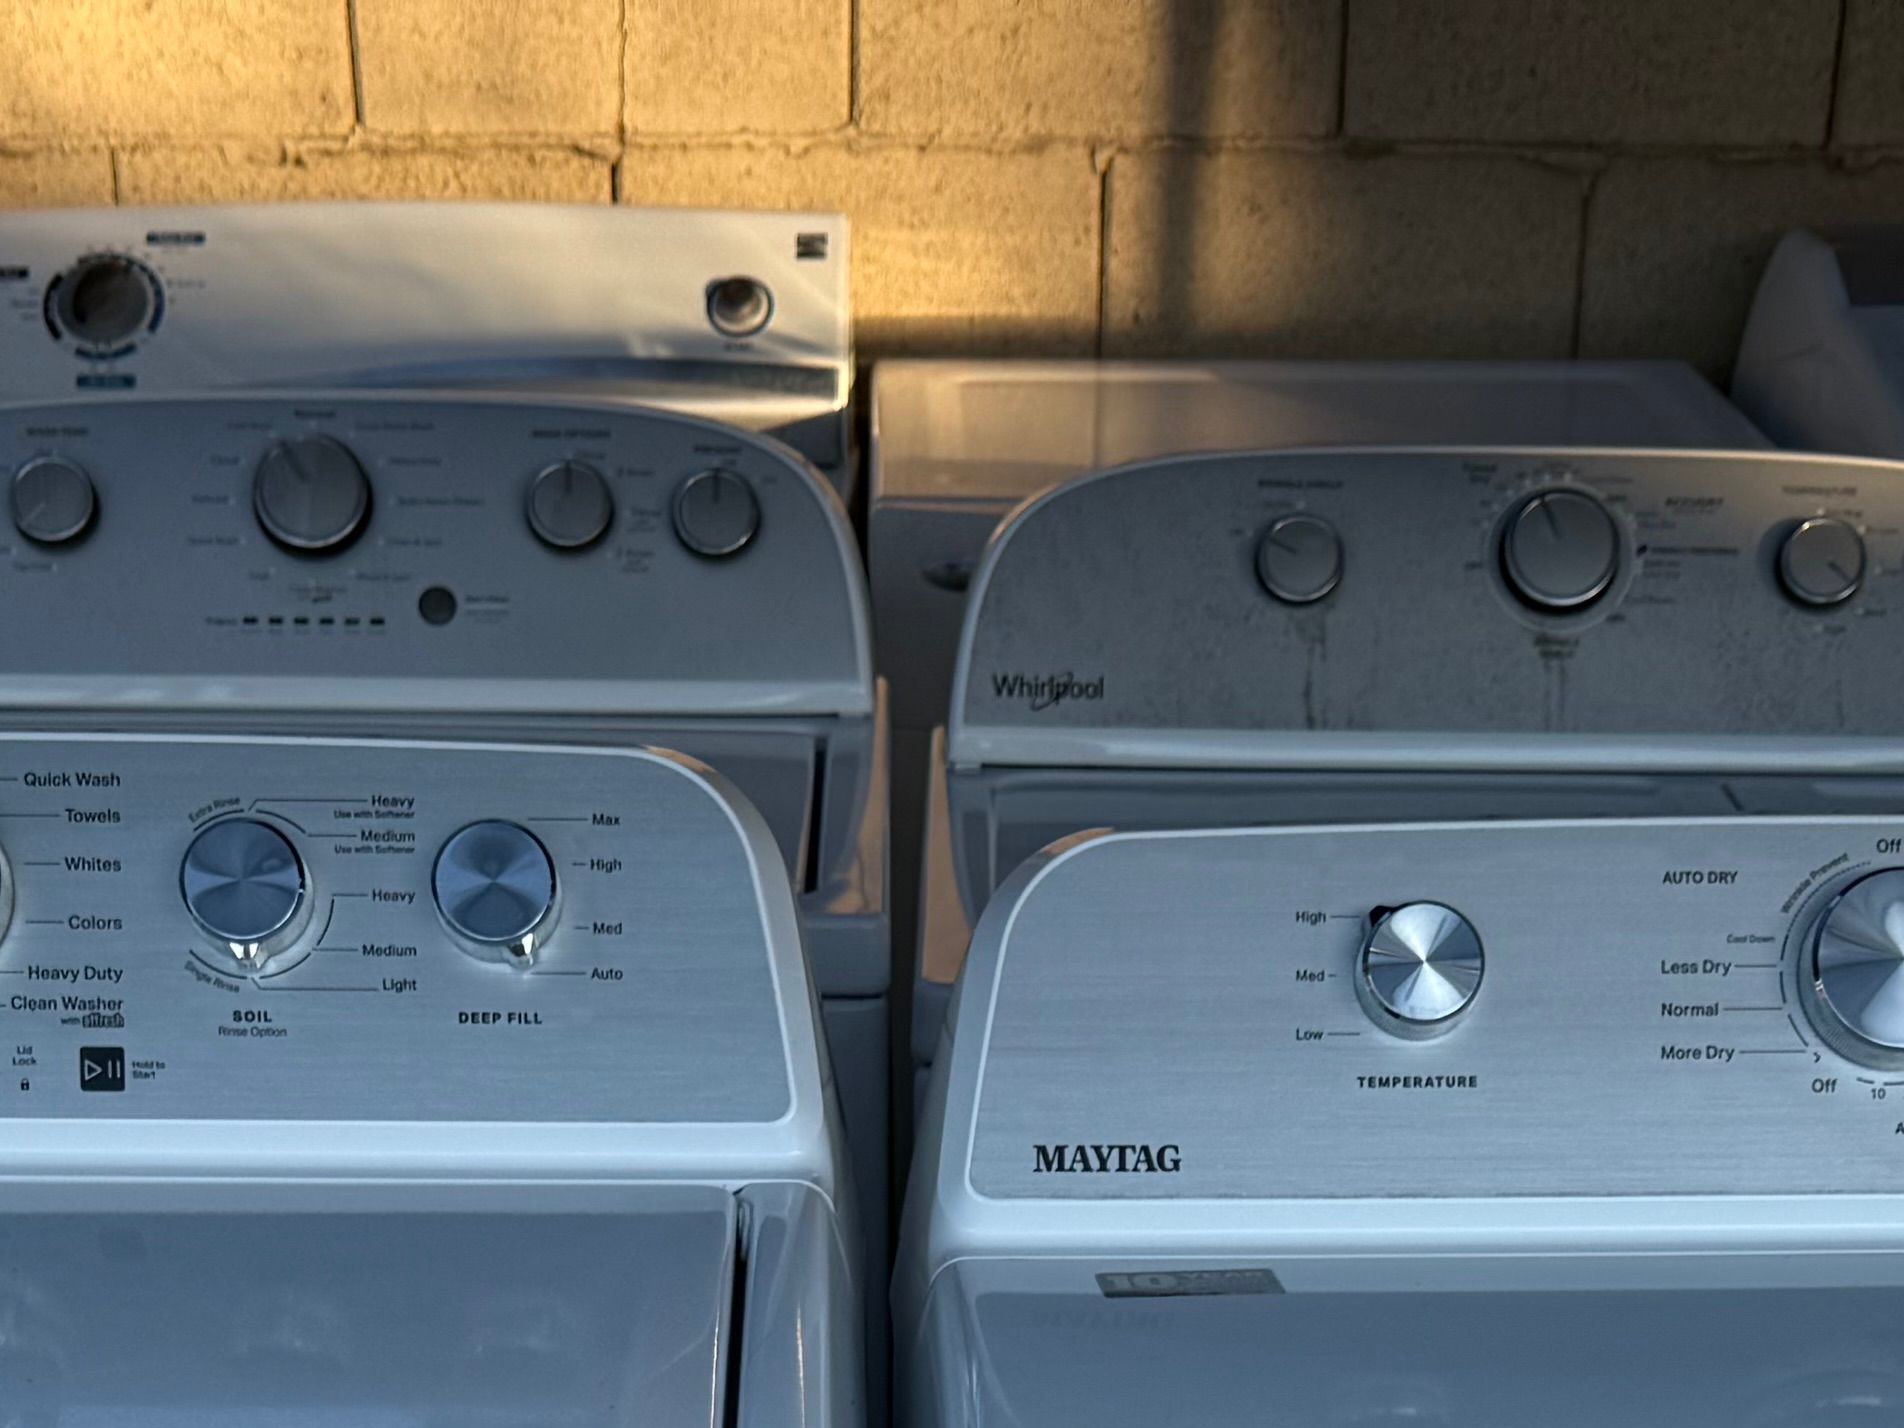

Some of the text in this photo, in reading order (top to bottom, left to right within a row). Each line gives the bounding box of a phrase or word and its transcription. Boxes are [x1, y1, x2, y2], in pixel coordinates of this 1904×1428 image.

[993, 672, 1104, 708] Whirlpool
[24, 772, 120, 786] Quick Wash
[372, 795, 414, 809] Heavy
[65, 808, 120, 823] Towels
[593, 814, 619, 825] Max
[361, 830, 415, 842] Medium
[1876, 839, 1901, 853] Off
[65, 857, 121, 871] Whites
[591, 859, 621, 873] High
[1663, 871, 1737, 884] AUTO DRY
[373, 889, 415, 904] Heavy
[68, 915, 122, 929] Colors
[1296, 912, 1326, 925] High
[593, 922, 622, 934] Med
[363, 944, 417, 956] Medium
[28, 966, 123, 983] Heavy Duty
[591, 968, 623, 980] Auto
[1661, 959, 1731, 976] Less Dry
[1296, 970, 1324, 981] Med
[383, 979, 416, 993] Light
[11, 996, 123, 1011] Clean Washer
[1662, 1003, 1718, 1016] Normal
[233, 1010, 272, 1022] SOIL
[459, 1012, 542, 1024] DEEP FILL
[218, 1026, 287, 1038] Rinse Option
[1296, 1028, 1323, 1040] Low
[1661, 1045, 1735, 1062] More Dry
[1357, 1076, 1476, 1088] TEMPERATURE
[1812, 1079, 1837, 1093] Off
[1871, 1088, 1886, 1099] 10
[1033, 1145, 1181, 1172] MAYTAG
